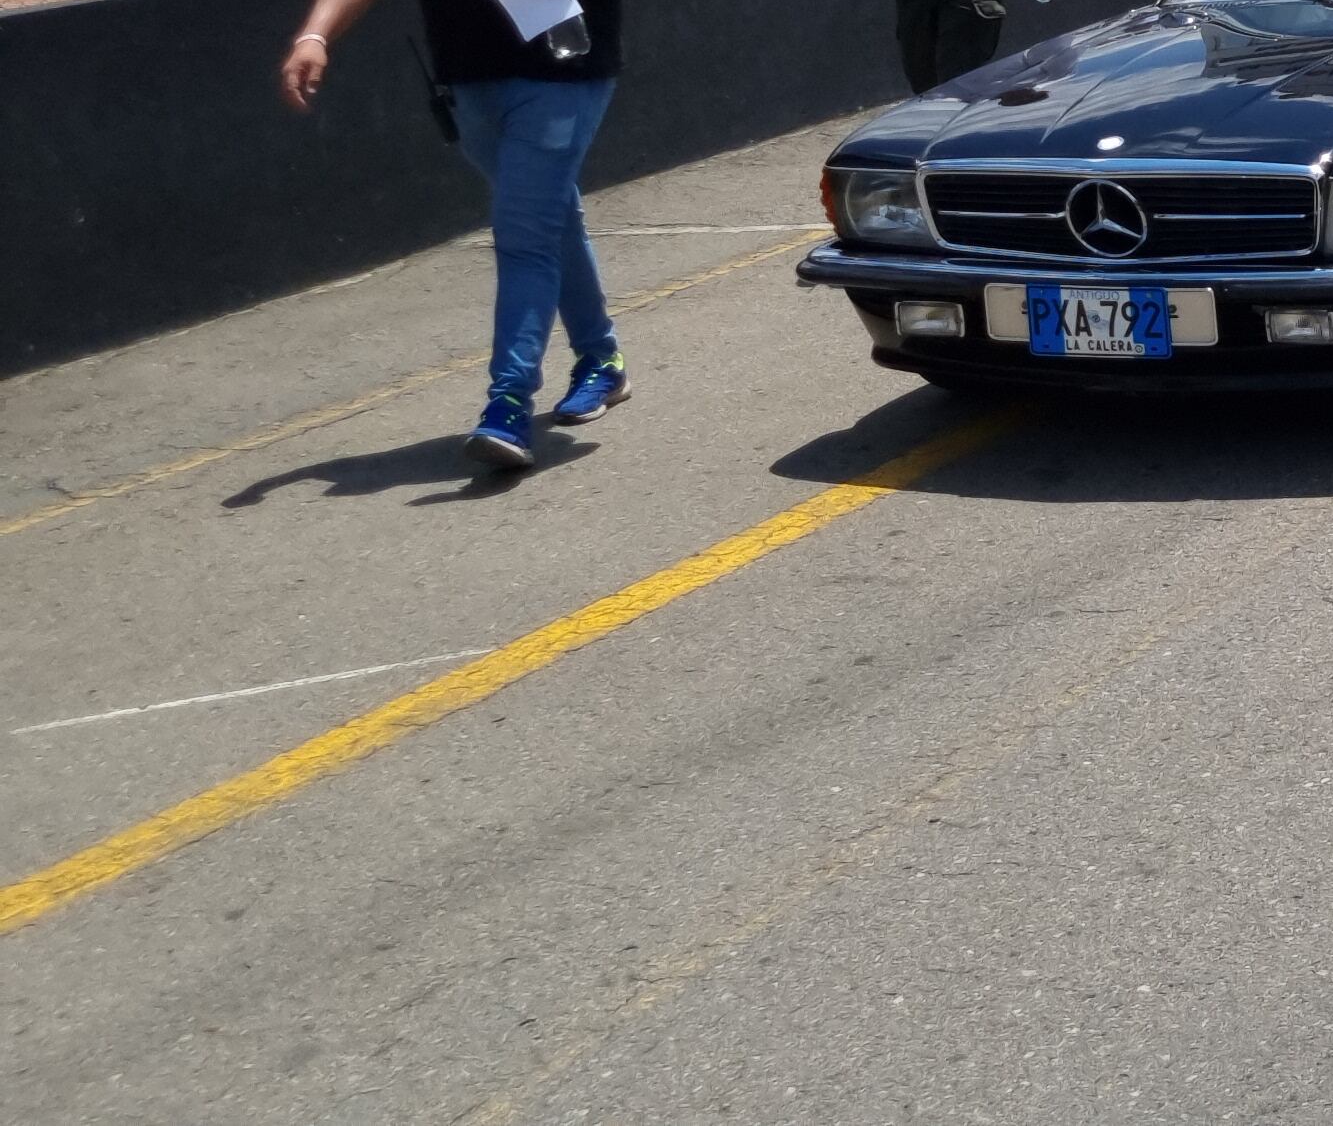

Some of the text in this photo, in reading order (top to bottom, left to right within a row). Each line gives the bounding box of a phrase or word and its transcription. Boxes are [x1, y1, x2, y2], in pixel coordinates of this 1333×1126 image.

[1069, 290, 1120, 301] ANTIGUO
[1032, 297, 1163, 339] PXA 792
[1066, 340, 1133, 352] LA CALERA
